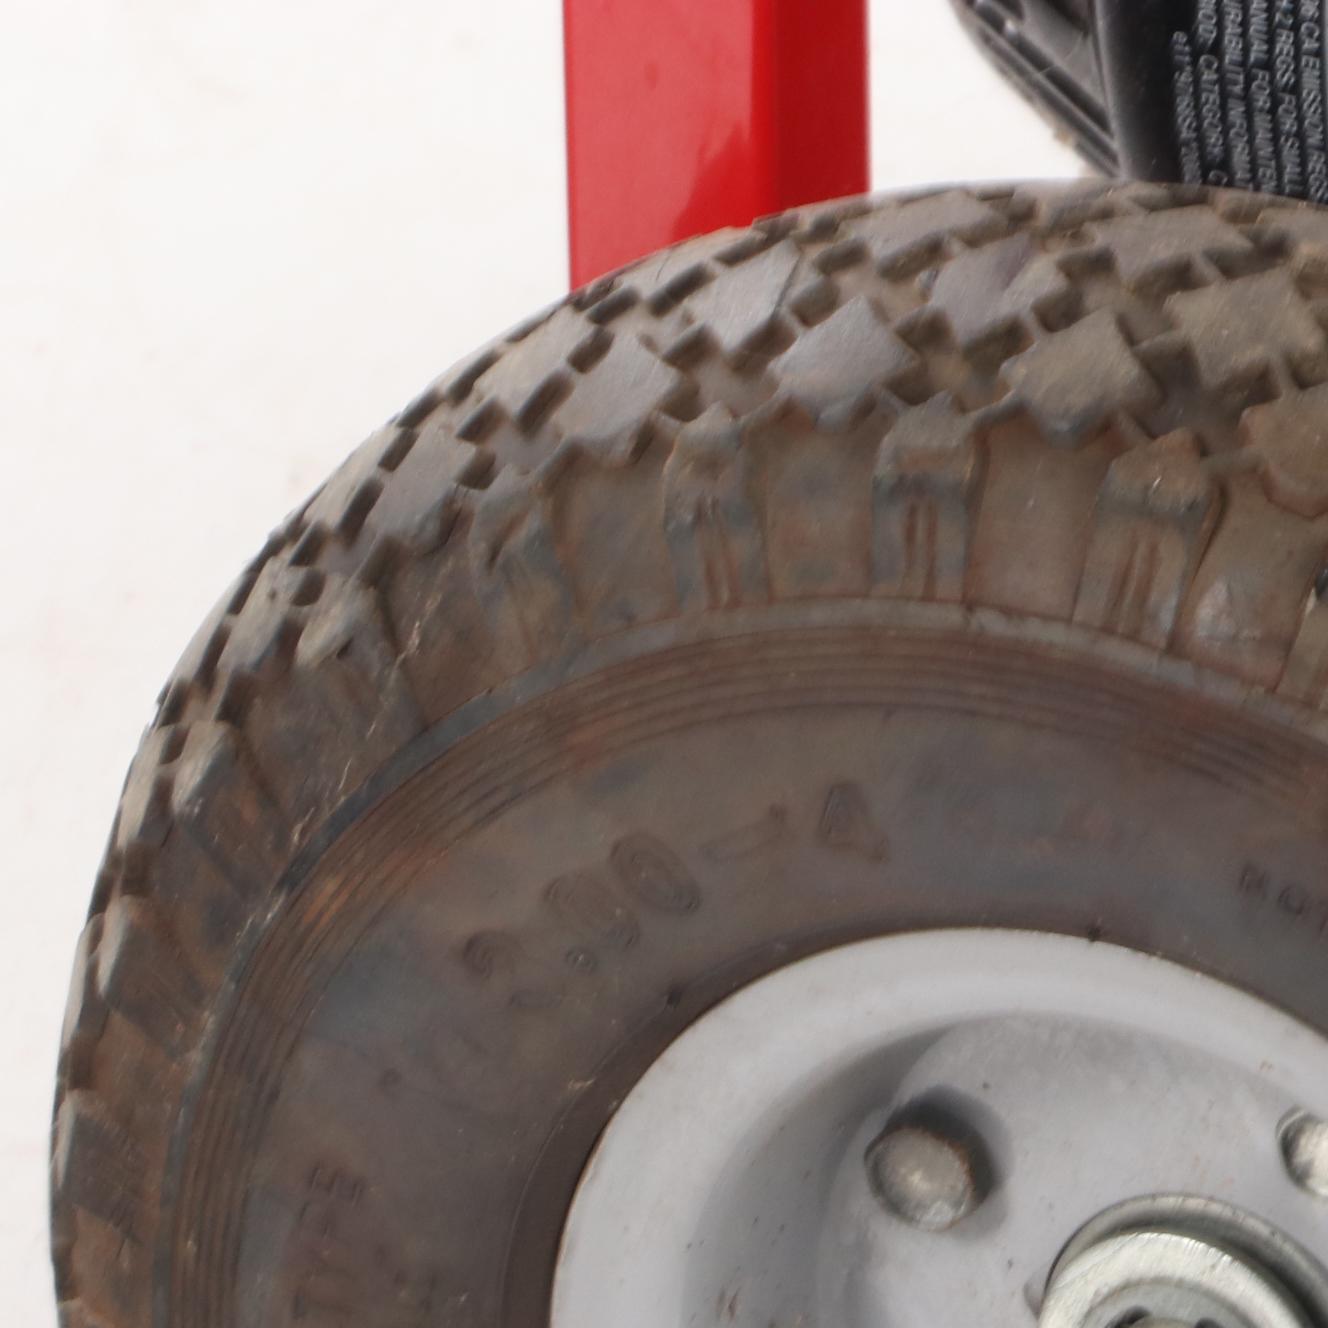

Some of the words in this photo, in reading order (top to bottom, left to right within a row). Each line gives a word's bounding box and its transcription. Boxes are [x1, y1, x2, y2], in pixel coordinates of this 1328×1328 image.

[1300, 21, 1320, 49] CA
[1251, 68, 1272, 111] FOR
[1301, 55, 1324, 145] EMISSION
[1277, 93, 1299, 134] FOR
[291, 1164, 367, 1322] TYPE
